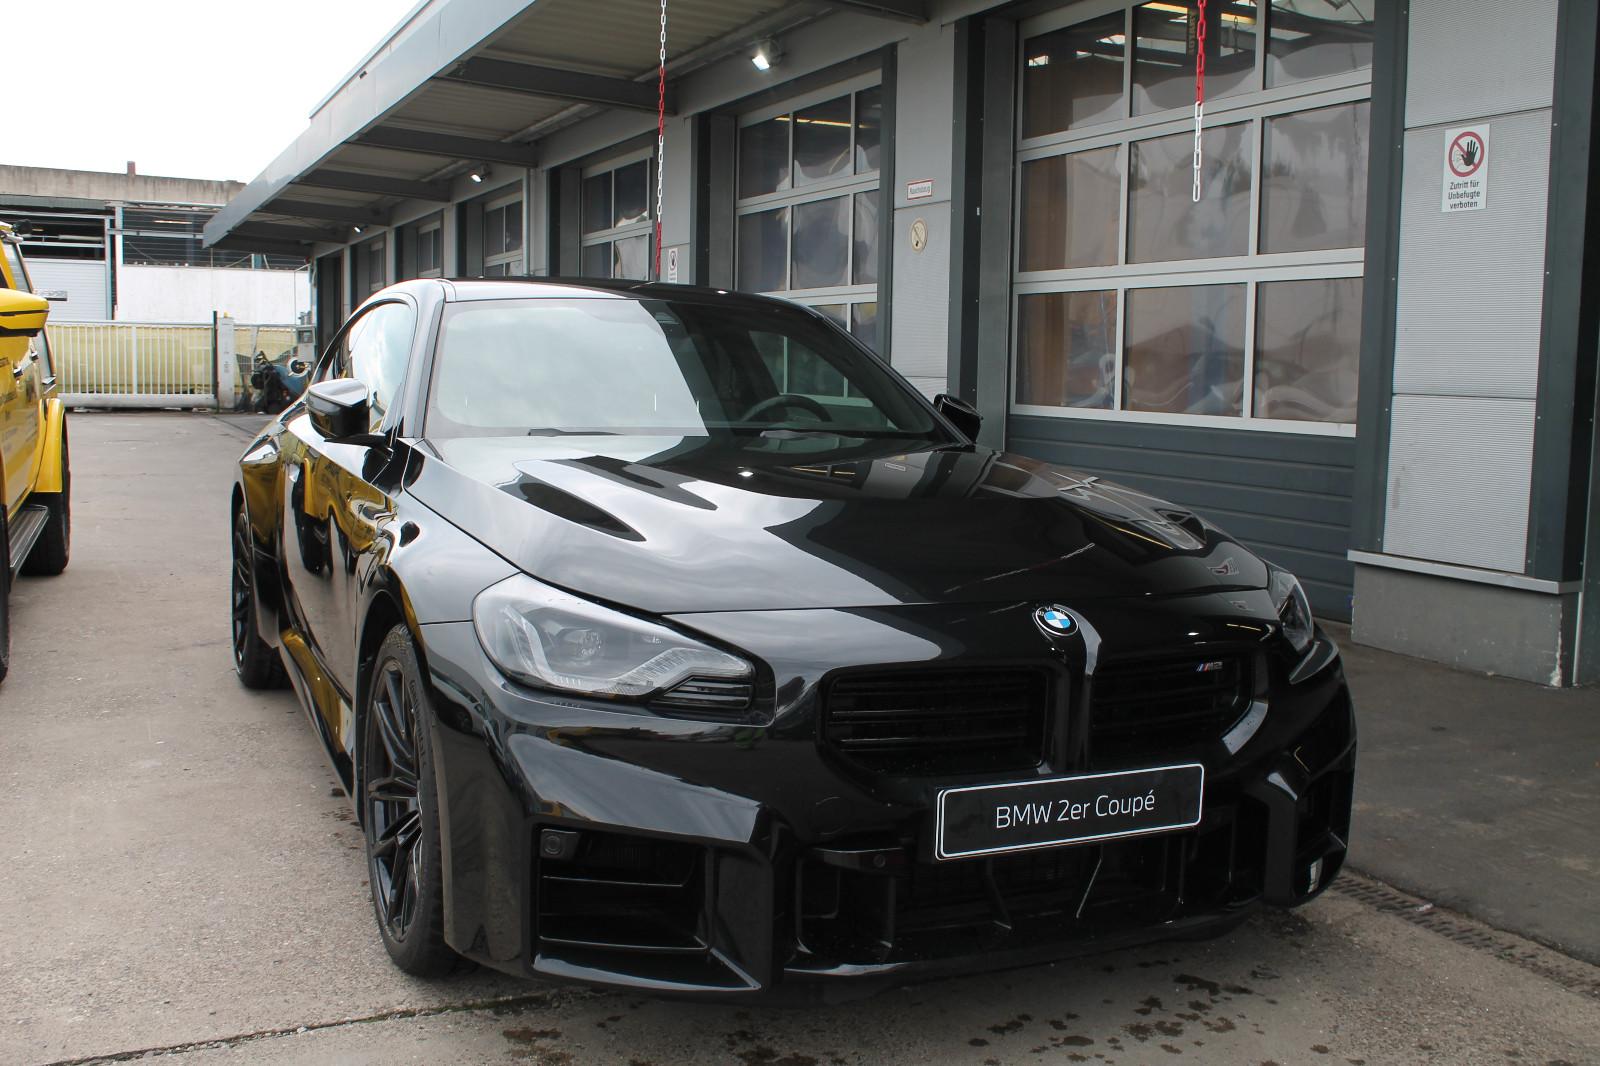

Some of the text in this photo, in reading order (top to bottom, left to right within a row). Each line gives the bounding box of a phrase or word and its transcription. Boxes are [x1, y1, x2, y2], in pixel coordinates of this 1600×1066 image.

[1449, 180, 1480, 190] Zutritt für
[1448, 191, 1480, 200] Unbefugte
[1449, 201, 1478, 209] verboten
[995, 789, 1155, 829] BMW 2er Coupé
